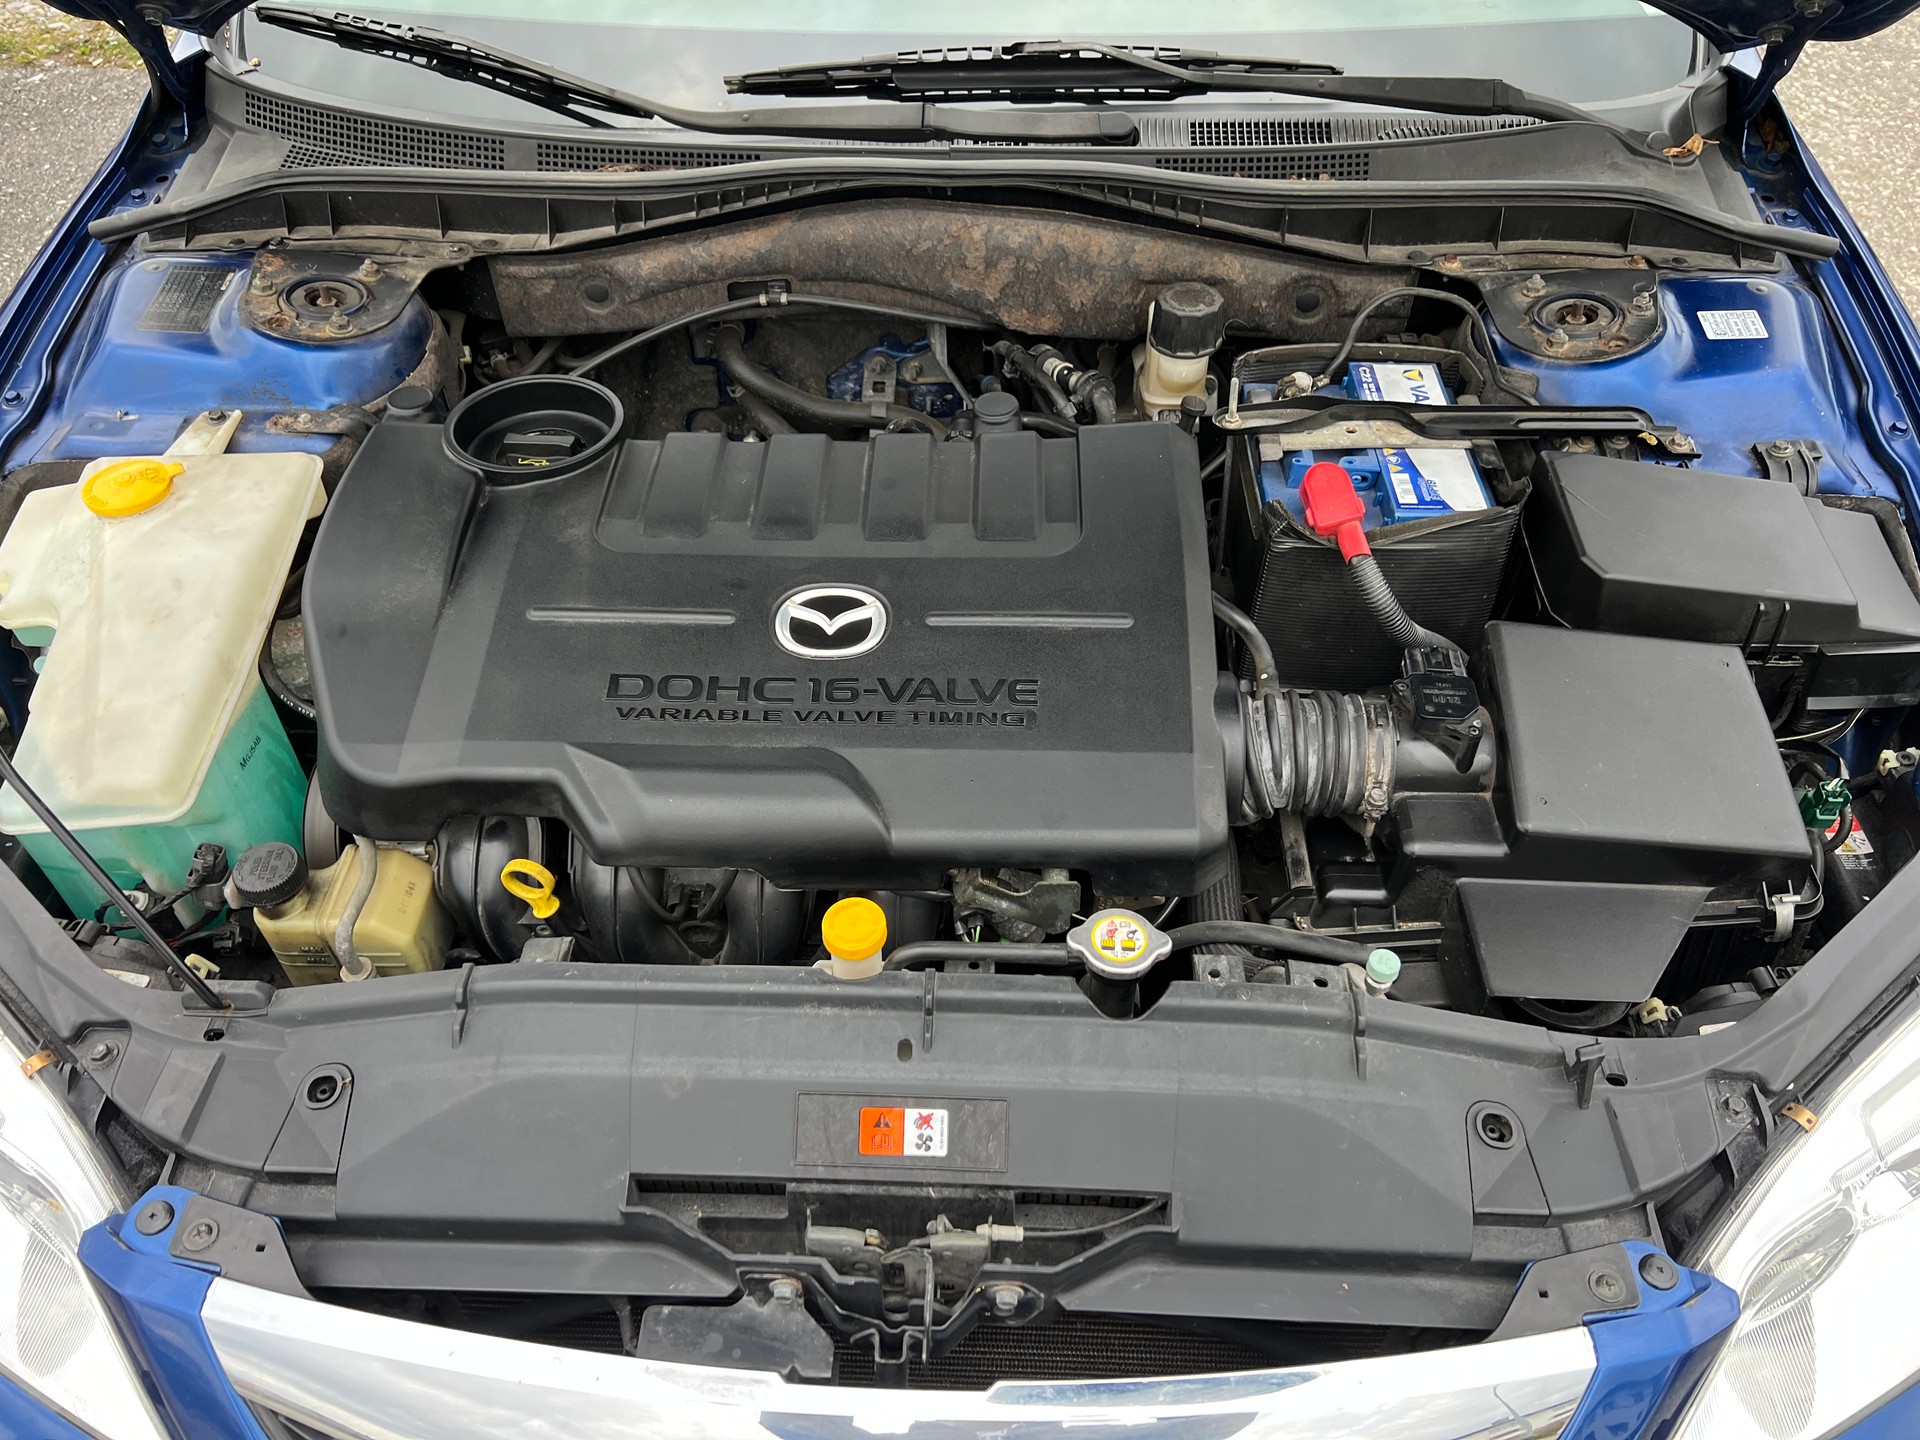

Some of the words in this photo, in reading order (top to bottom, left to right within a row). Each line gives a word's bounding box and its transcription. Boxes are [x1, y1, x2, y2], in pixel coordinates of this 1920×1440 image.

[1409, 384, 1431, 404] VA
[604, 672, 796, 705] DOHC
[808, 676, 1040, 707] 16-VALVE
[615, 706, 783, 723] VARIABLE
[793, 709, 897, 725] VALVE
[908, 710, 1026, 727] TIMING
